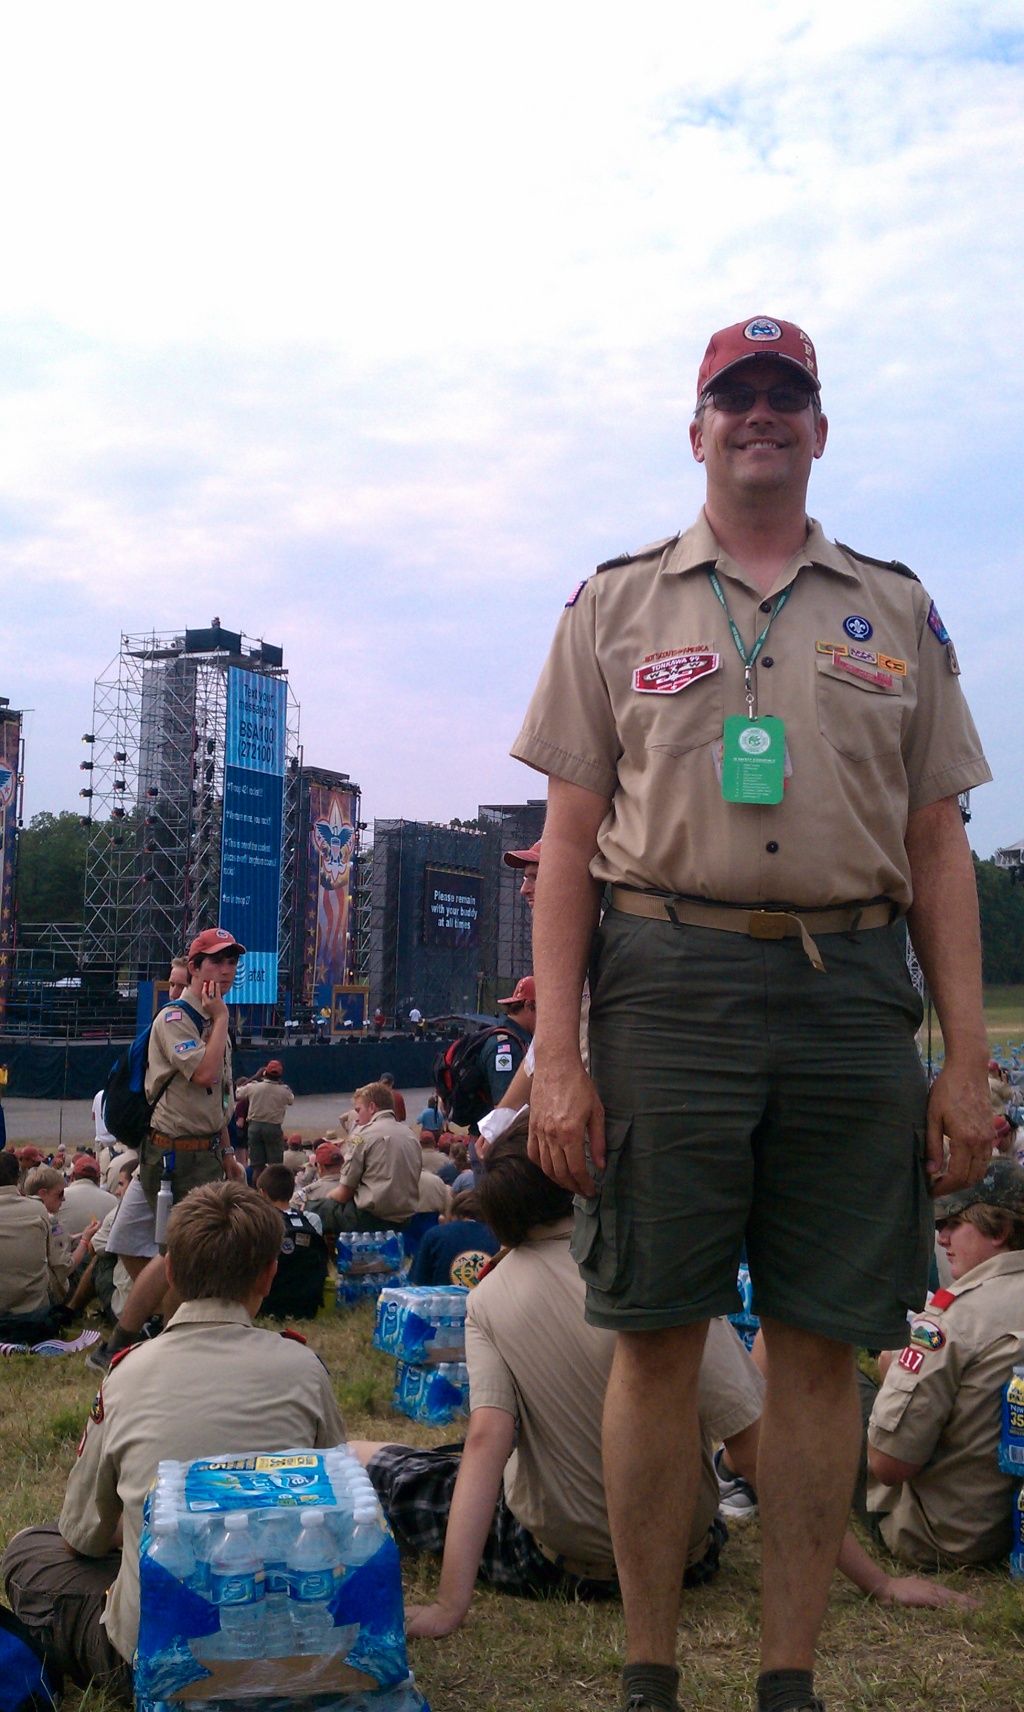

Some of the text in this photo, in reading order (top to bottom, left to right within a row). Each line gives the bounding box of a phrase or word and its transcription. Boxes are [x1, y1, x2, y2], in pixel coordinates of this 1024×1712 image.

[651, 657, 688, 672] TONKAWA
[244, 684, 274, 704] Text your
[239, 700, 268, 719] message
[240, 720, 274, 744] BSA100
[238, 740, 274, 768] (272100)
[434, 890, 475, 905] Please remain
[431, 904, 478, 920] with your buddy
[438, 917, 444, 927] at
[455, 918, 470, 929] times
[248, 968, 266, 983] at&t
[899, 1347, 924, 1370] 117
